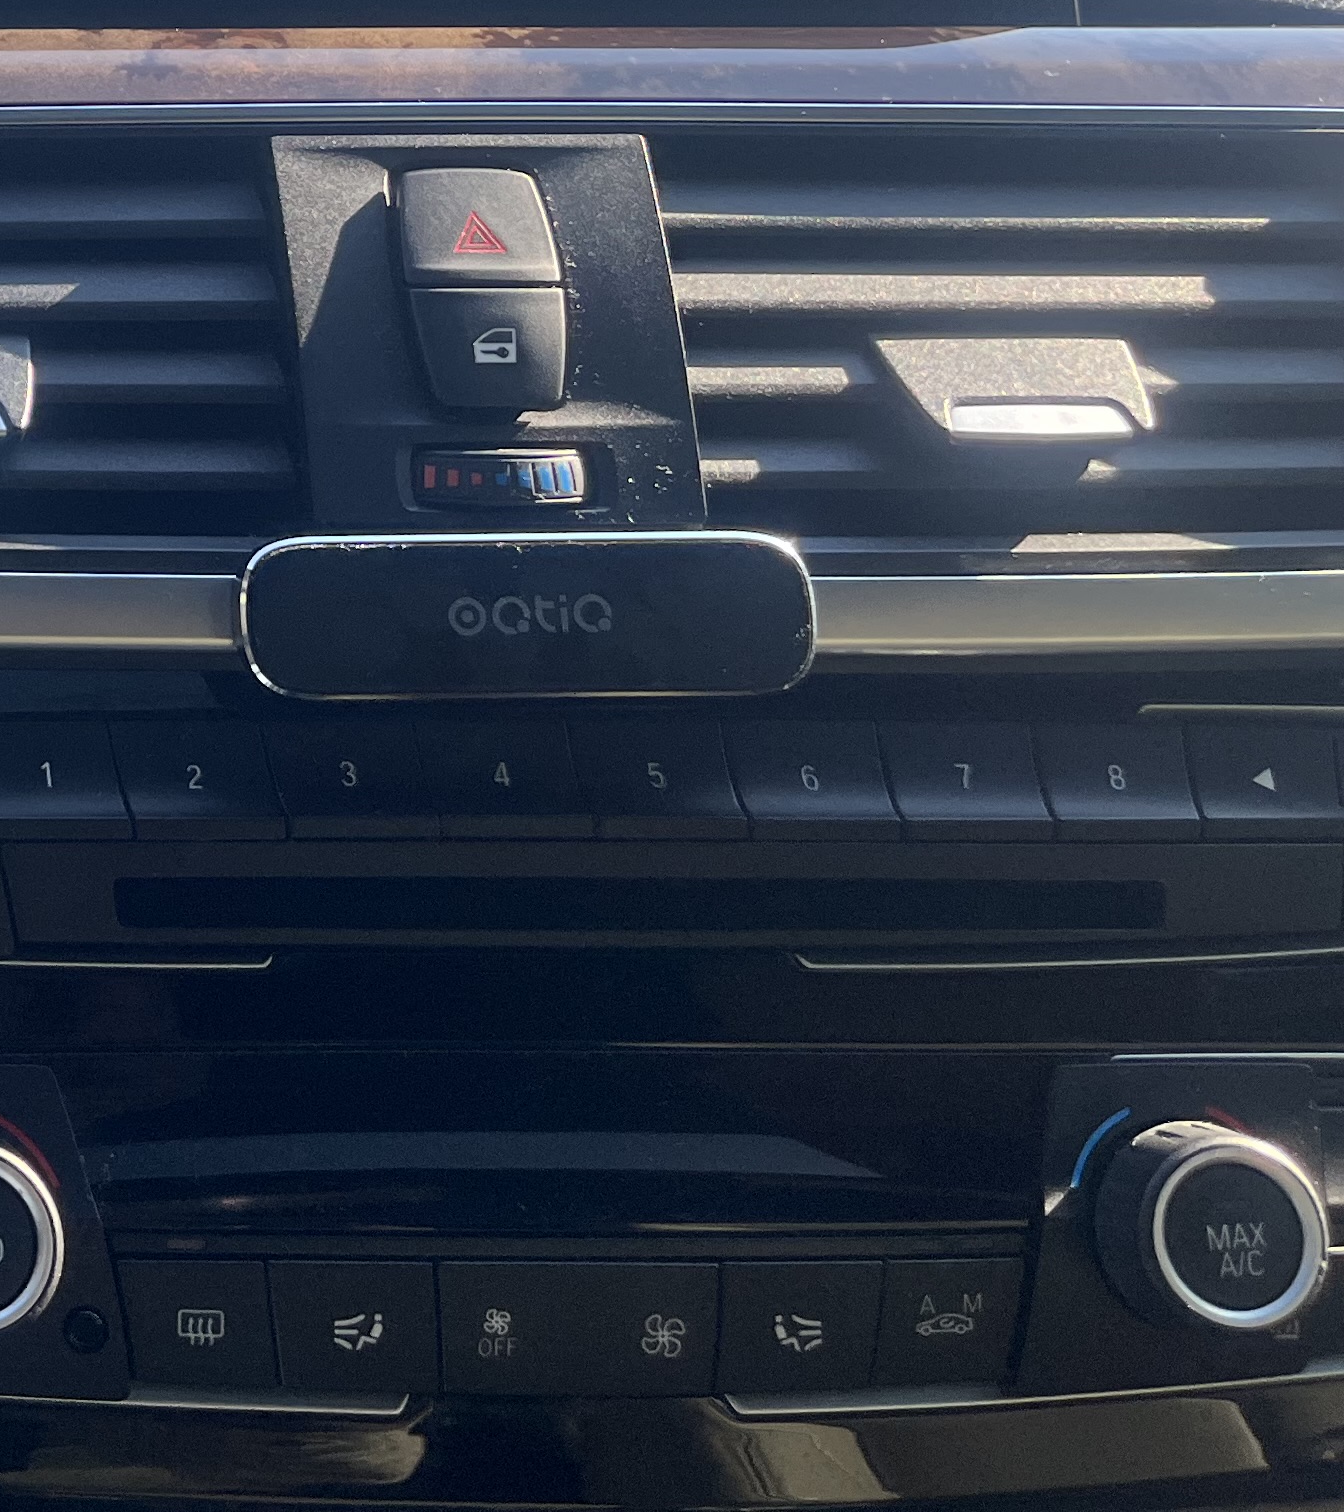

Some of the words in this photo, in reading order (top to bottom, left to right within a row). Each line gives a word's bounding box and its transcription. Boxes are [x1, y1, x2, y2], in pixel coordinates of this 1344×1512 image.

[42, 762, 52, 787] 1
[187, 765, 202, 789] 2
[340, 761, 357, 786] 3
[495, 762, 510, 786] 4
[648, 763, 666, 788] 5
[801, 765, 818, 790] 6
[955, 764, 970, 789] 7
[1108, 765, 1126, 790] 8
[1207, 1223, 1266, 1250] MAX
[1220, 1252, 1265, 1277] A/C
[920, 1295, 935, 1314] A
[963, 1293, 982, 1312] M
[478, 1337, 516, 1357] OFF
